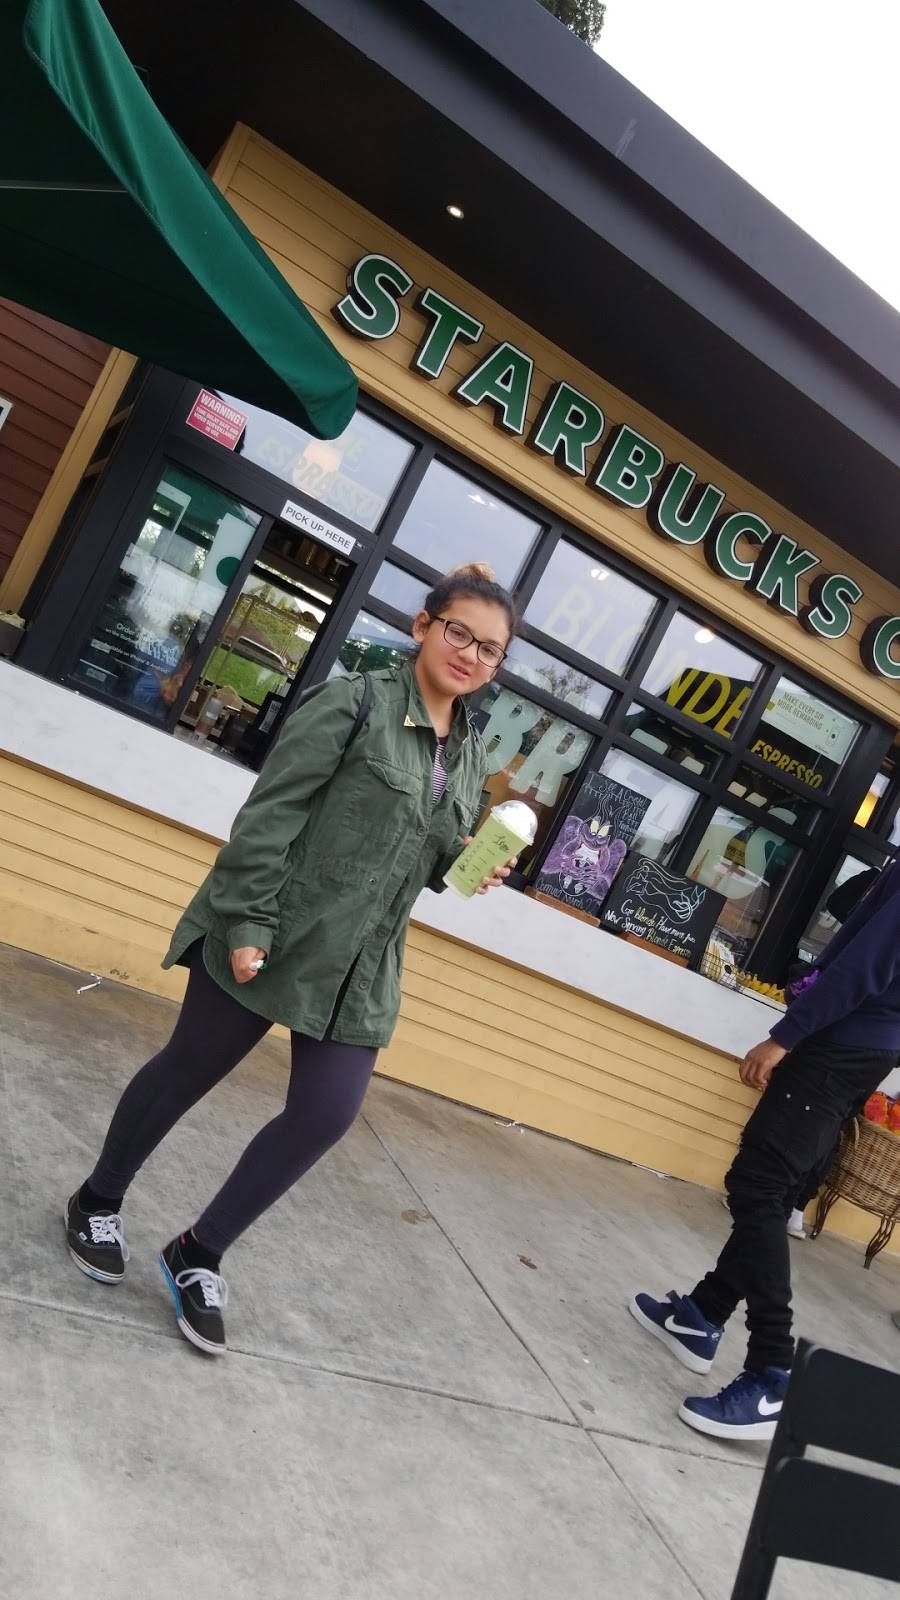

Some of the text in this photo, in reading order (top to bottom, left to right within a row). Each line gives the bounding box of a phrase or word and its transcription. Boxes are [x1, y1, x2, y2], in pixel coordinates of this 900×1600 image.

[200, 393, 246, 427] WARNING!
[334, 252, 863, 640] STARBUCKS
[285, 506, 352, 550] PICK UP HERE
[116, 623, 136, 636] Order
[778, 699, 792, 713] MORE
[793, 707, 824, 731] REWARDING
[783, 692, 825, 721] MAKE EVERY SIP
[750, 739, 824, 790] ESPRESSO
[620, 898, 635, 917] Go
